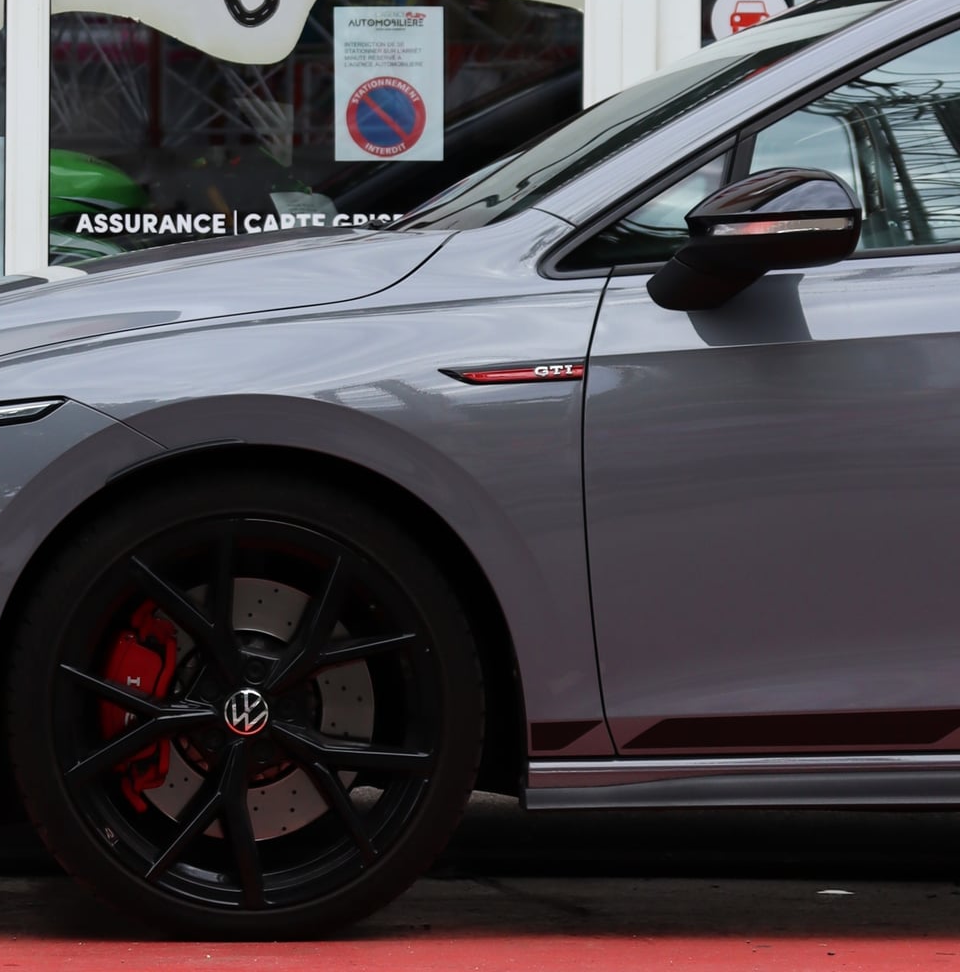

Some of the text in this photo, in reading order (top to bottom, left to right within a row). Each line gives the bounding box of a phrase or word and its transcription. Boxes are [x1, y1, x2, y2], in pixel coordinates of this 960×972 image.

[351, 77, 422, 105] STATIONNEMENT
[364, 141, 407, 156] INTERDIT
[76, 212, 227, 235] ASSURANCE
[533, 364, 573, 378] GTI
